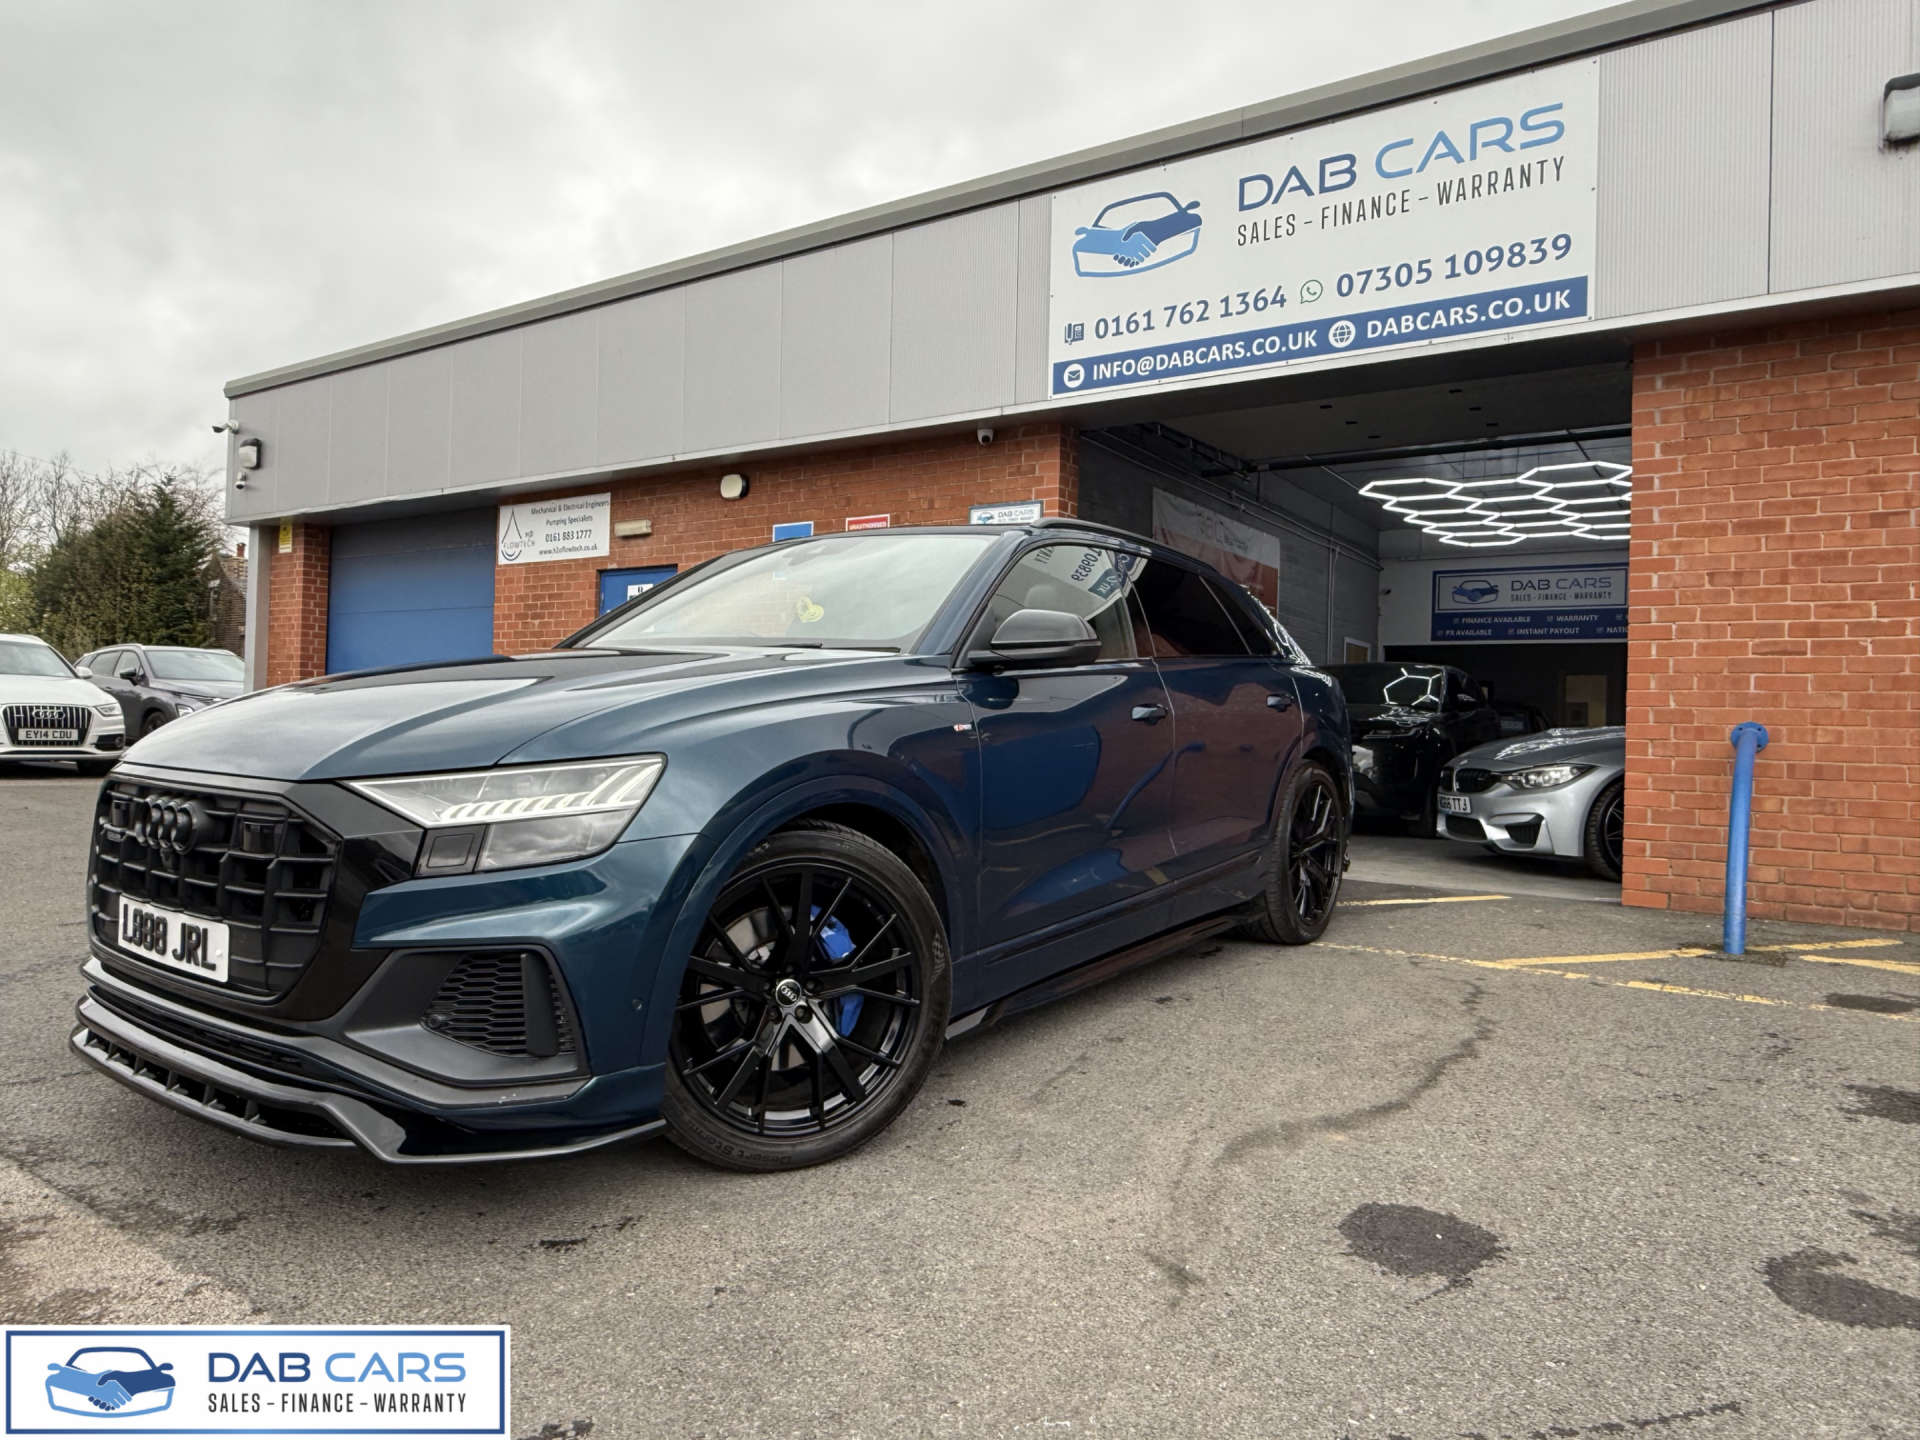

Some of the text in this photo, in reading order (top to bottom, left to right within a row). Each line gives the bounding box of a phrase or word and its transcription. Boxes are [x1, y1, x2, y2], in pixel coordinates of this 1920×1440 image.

[1238, 102, 1565, 212] DAB CARS
[1237, 213, 1297, 247] SALES
[1321, 189, 1411, 230] FINANCE
[1437, 155, 1566, 206] WARRANTY
[1336, 232, 1572, 298] 07305 109839
[1094, 285, 1287, 340] 0161 762 1364
[1366, 289, 1571, 340] DABCARS.CO.UK
[1092, 329, 1319, 382] INFO@DABCARS.CO.UK
[545, 532, 561, 543] 0161
[576, 529, 592, 540] 1777
[1511, 576, 1612, 592] DAB CARS
[1493, 615, 1531, 624] AVAILABLE
[1556, 614, 1600, 622] WARRANTY
[1549, 626, 1581, 635] PAYOUT
[25, 729, 49, 739] EY14
[172, 922, 217, 972] JRL
